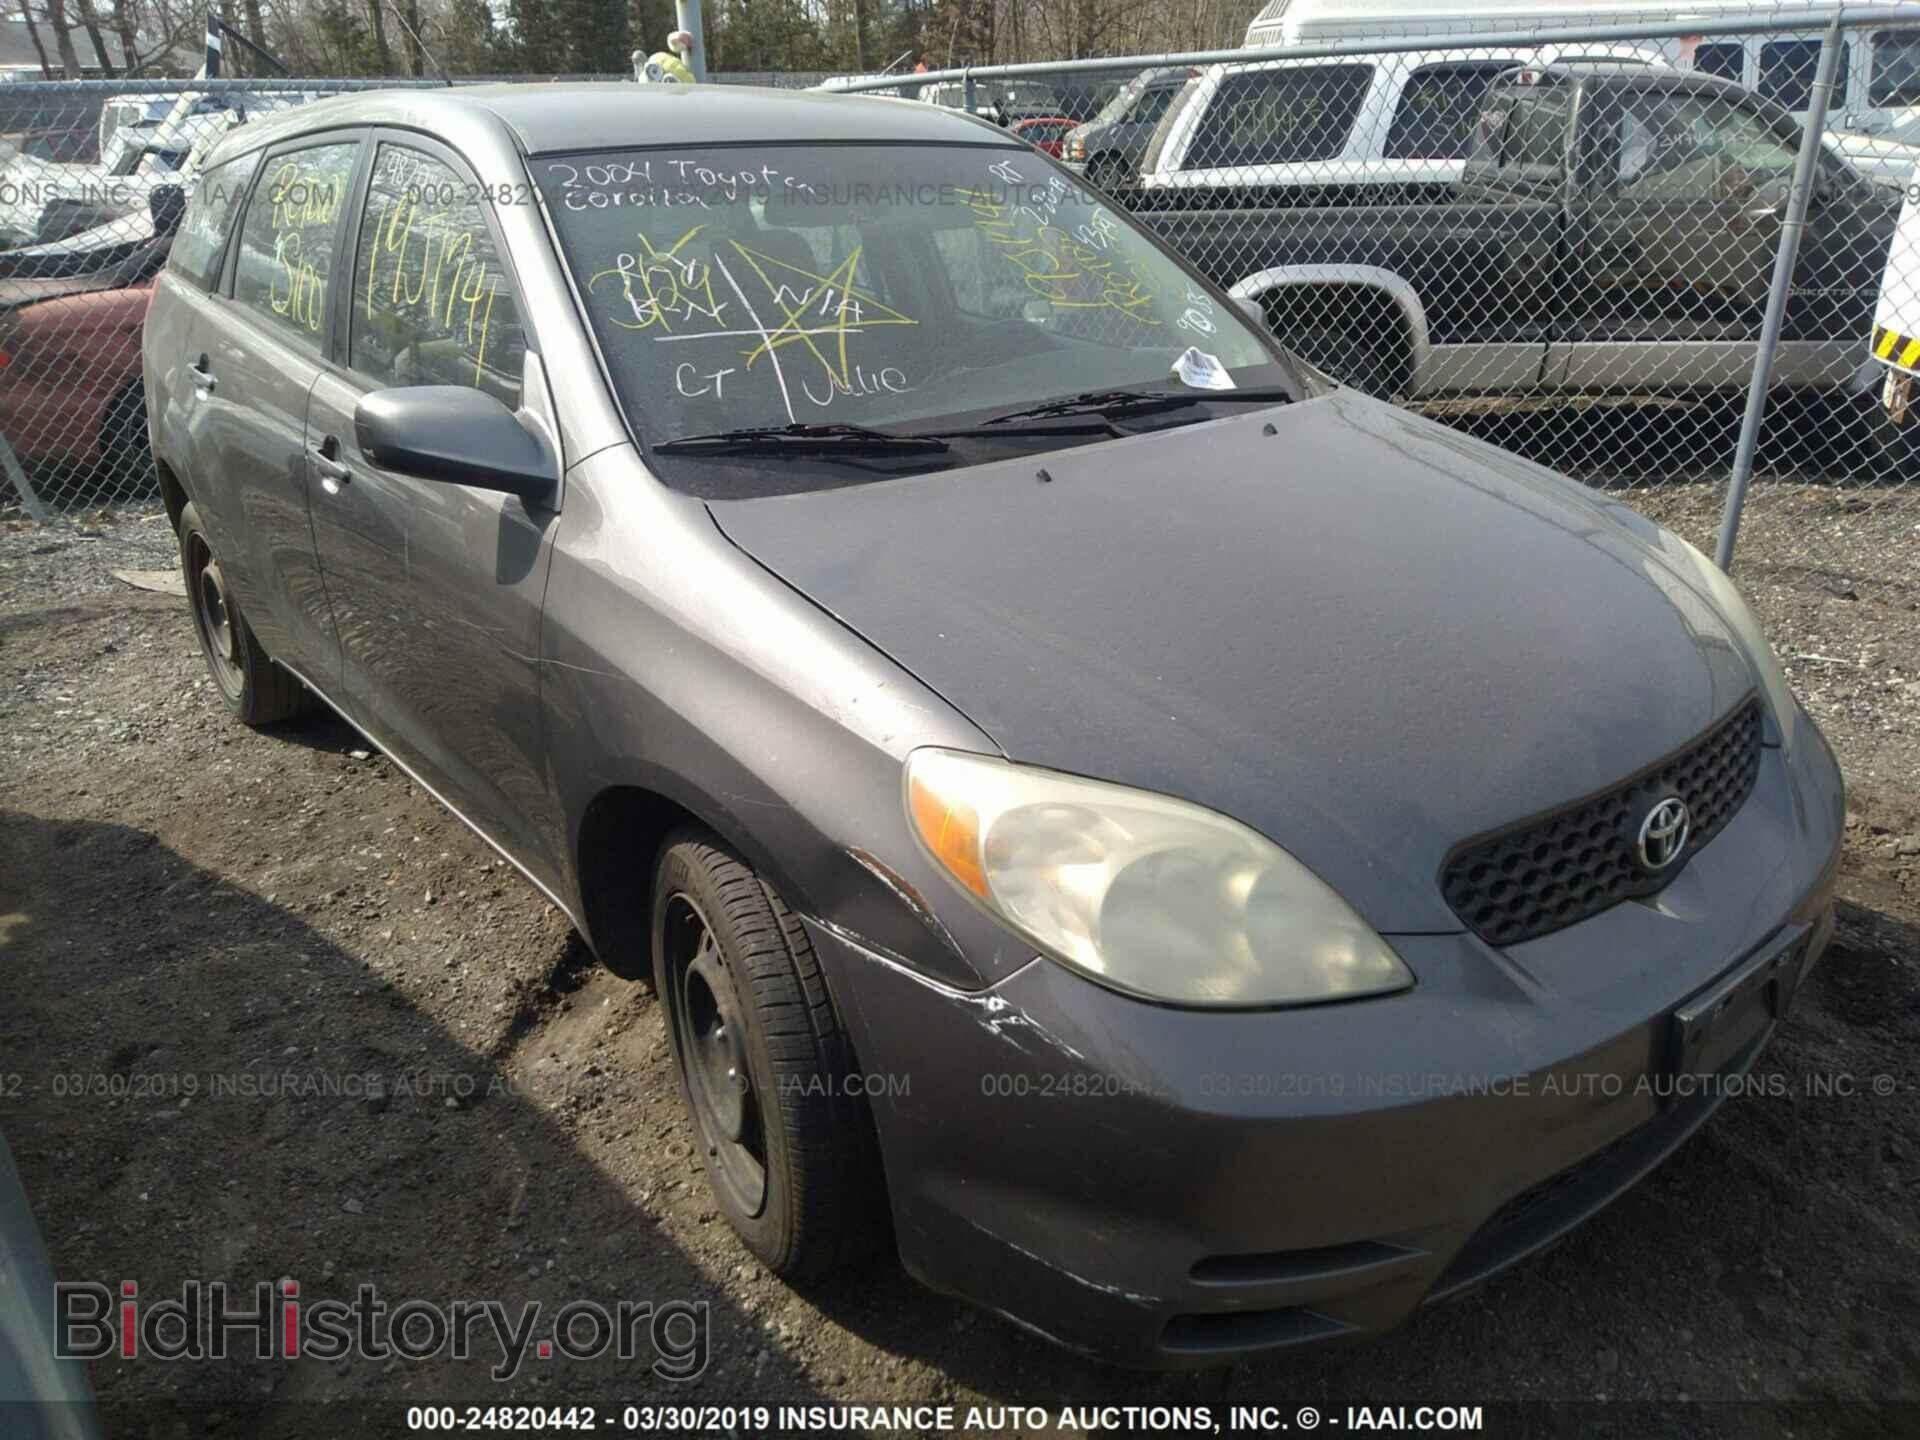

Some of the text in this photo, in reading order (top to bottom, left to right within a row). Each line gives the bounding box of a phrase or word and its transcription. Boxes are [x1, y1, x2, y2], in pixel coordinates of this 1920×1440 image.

[549, 160, 817, 200] 2004 Toyota
[676, 362, 736, 399] CT
